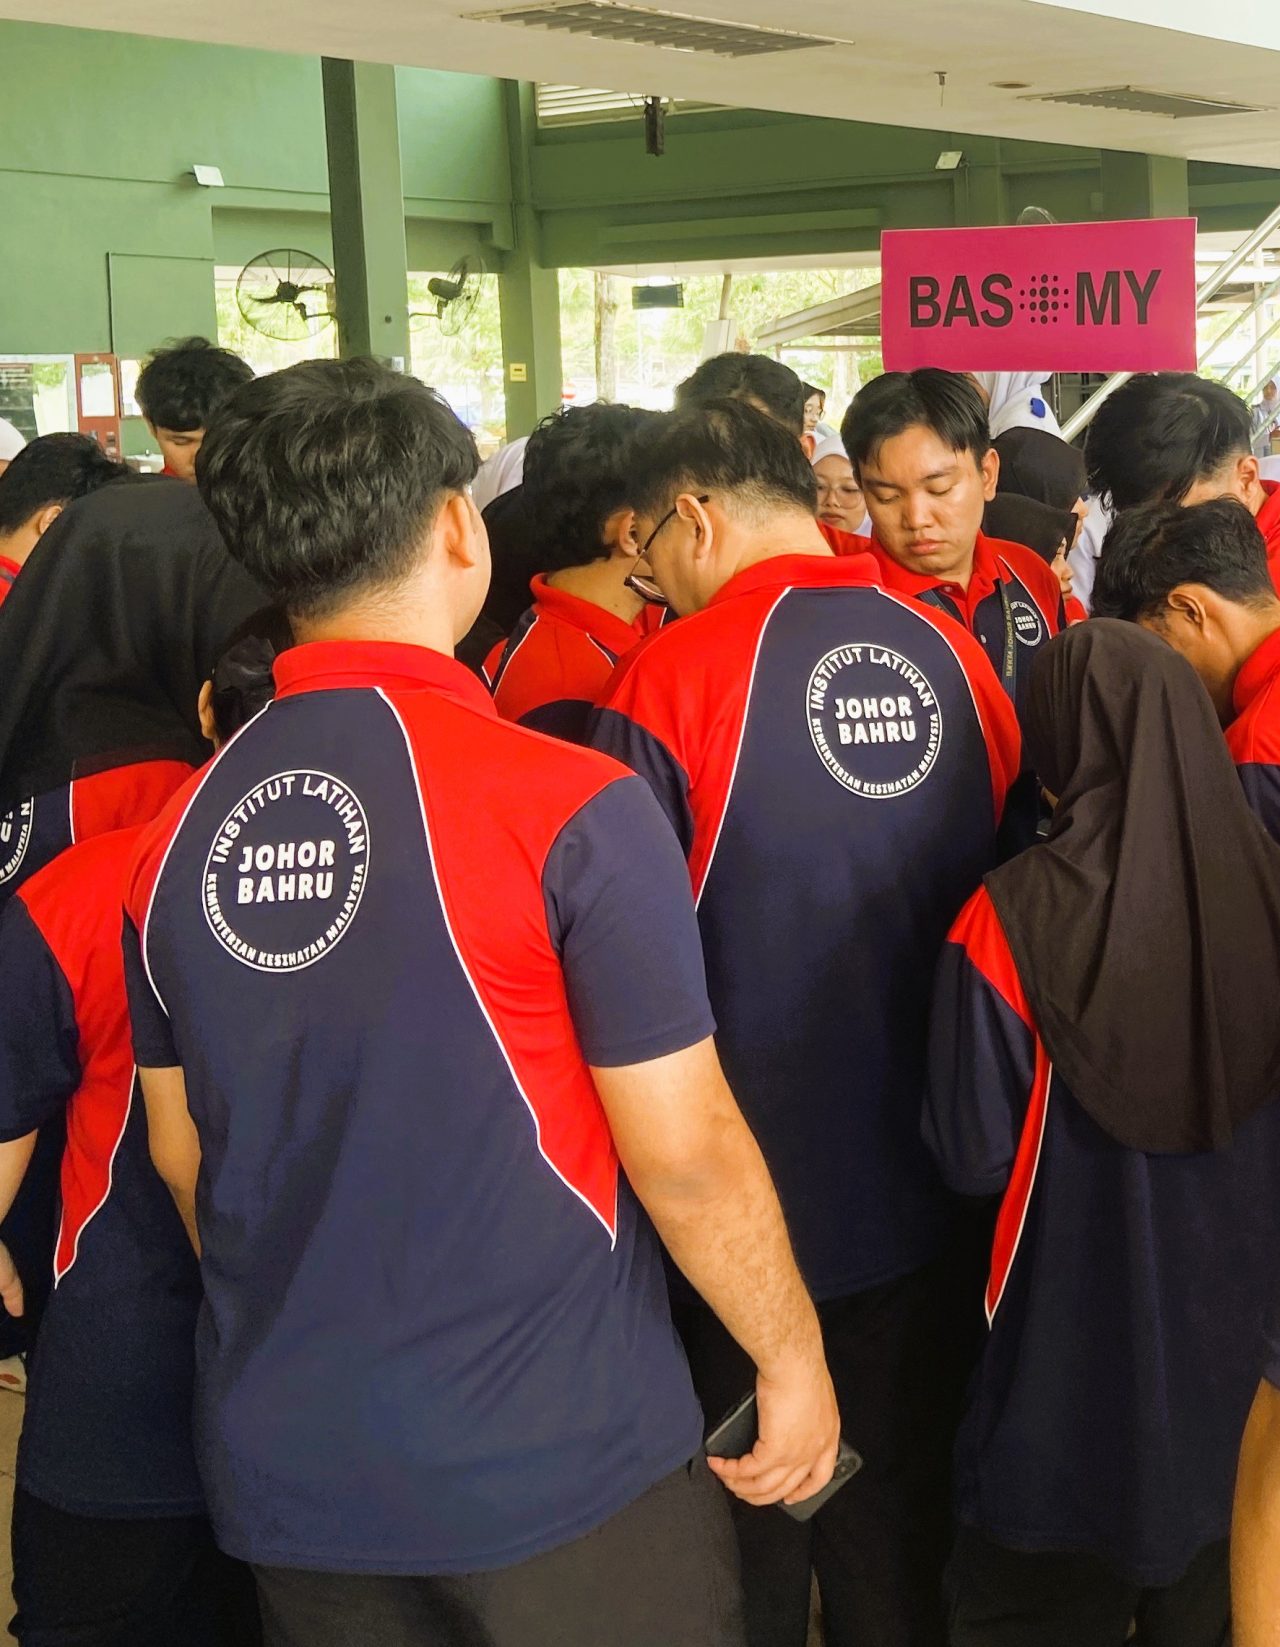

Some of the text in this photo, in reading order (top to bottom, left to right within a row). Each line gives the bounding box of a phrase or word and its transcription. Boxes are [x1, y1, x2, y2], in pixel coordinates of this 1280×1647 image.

[909, 269, 1162, 328] BAS MY
[810, 647, 935, 711] INSTITUT LATIHAN
[834, 696, 913, 720] JOHOR
[811, 713, 939, 795] KEMENTERIAN KESIHATAN MALAYSIA
[838, 720, 917, 745] BAHRU
[212, 775, 366, 864] INSTITUT LATIHAN
[237, 839, 336, 873] JOHOR
[206, 863, 365, 967] KEMENTERIAN KESIHATAN MALAYSIA
[236, 872, 334, 905] BAHRU
